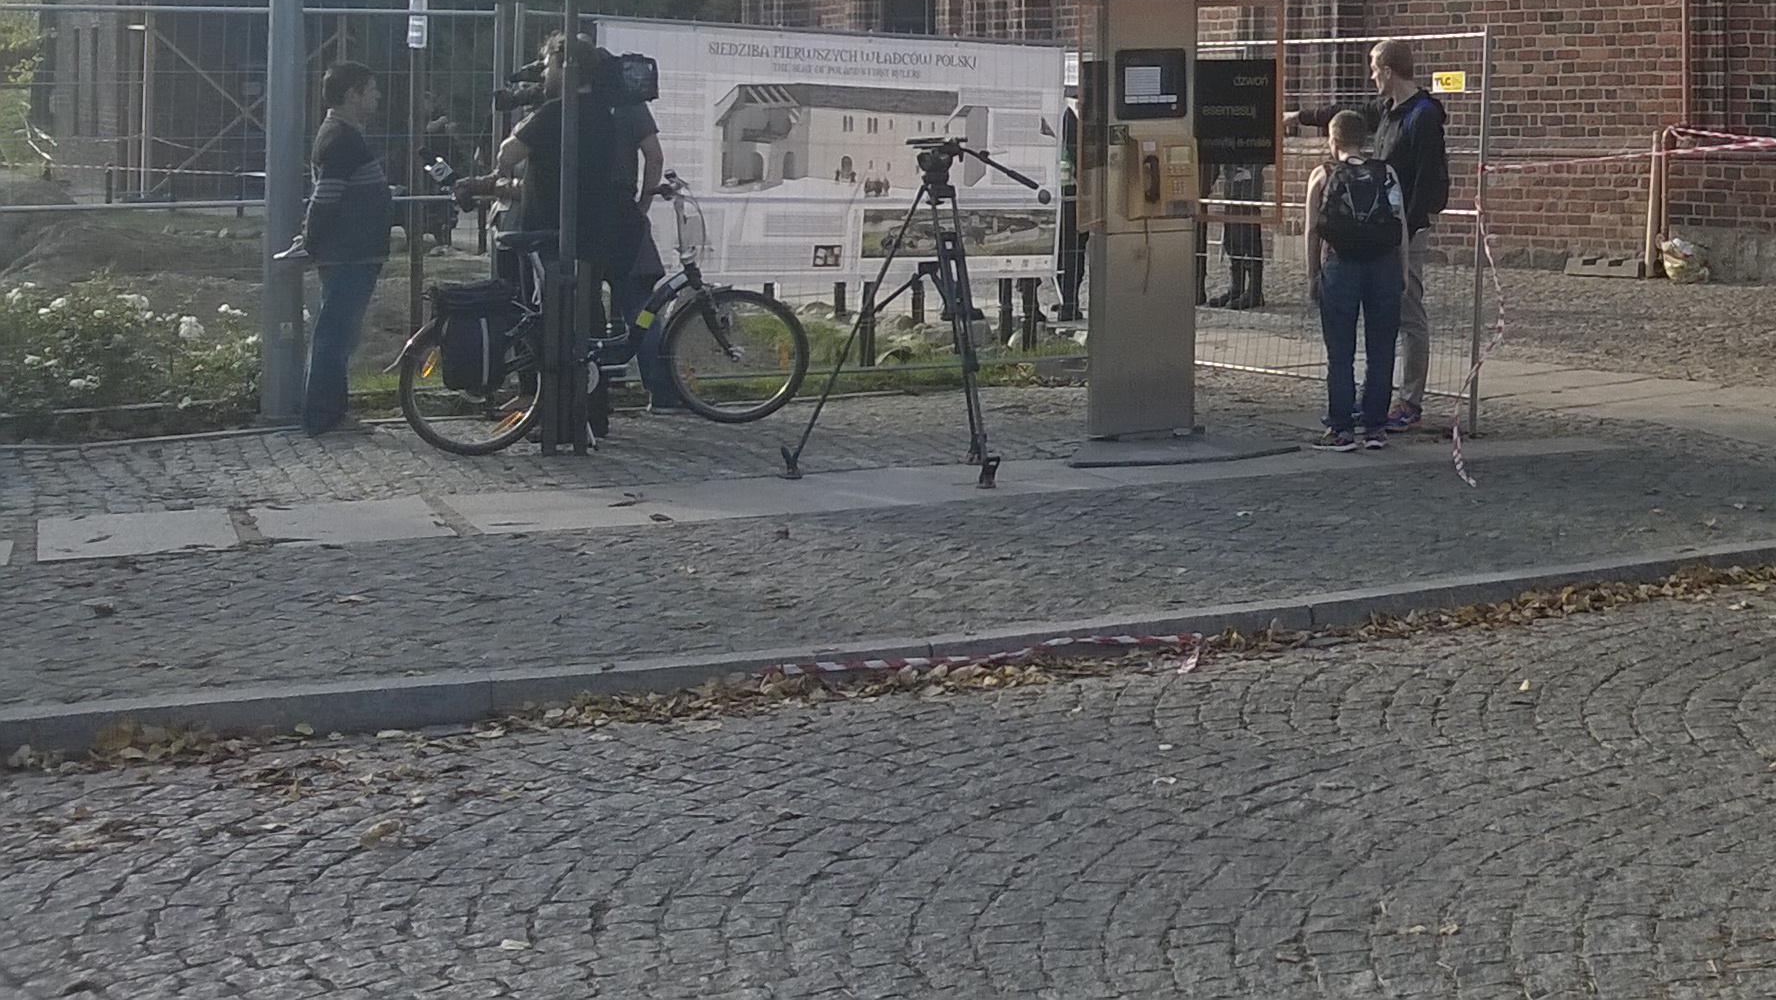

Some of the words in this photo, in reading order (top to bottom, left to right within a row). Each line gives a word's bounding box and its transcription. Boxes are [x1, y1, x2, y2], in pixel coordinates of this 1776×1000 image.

[708, 41, 769, 59] SIEDZIBA
[773, 45, 858, 62] PIERWSZYCH
[935, 53, 977, 70] POLSKI
[1434, 76, 1452, 87] TLC
